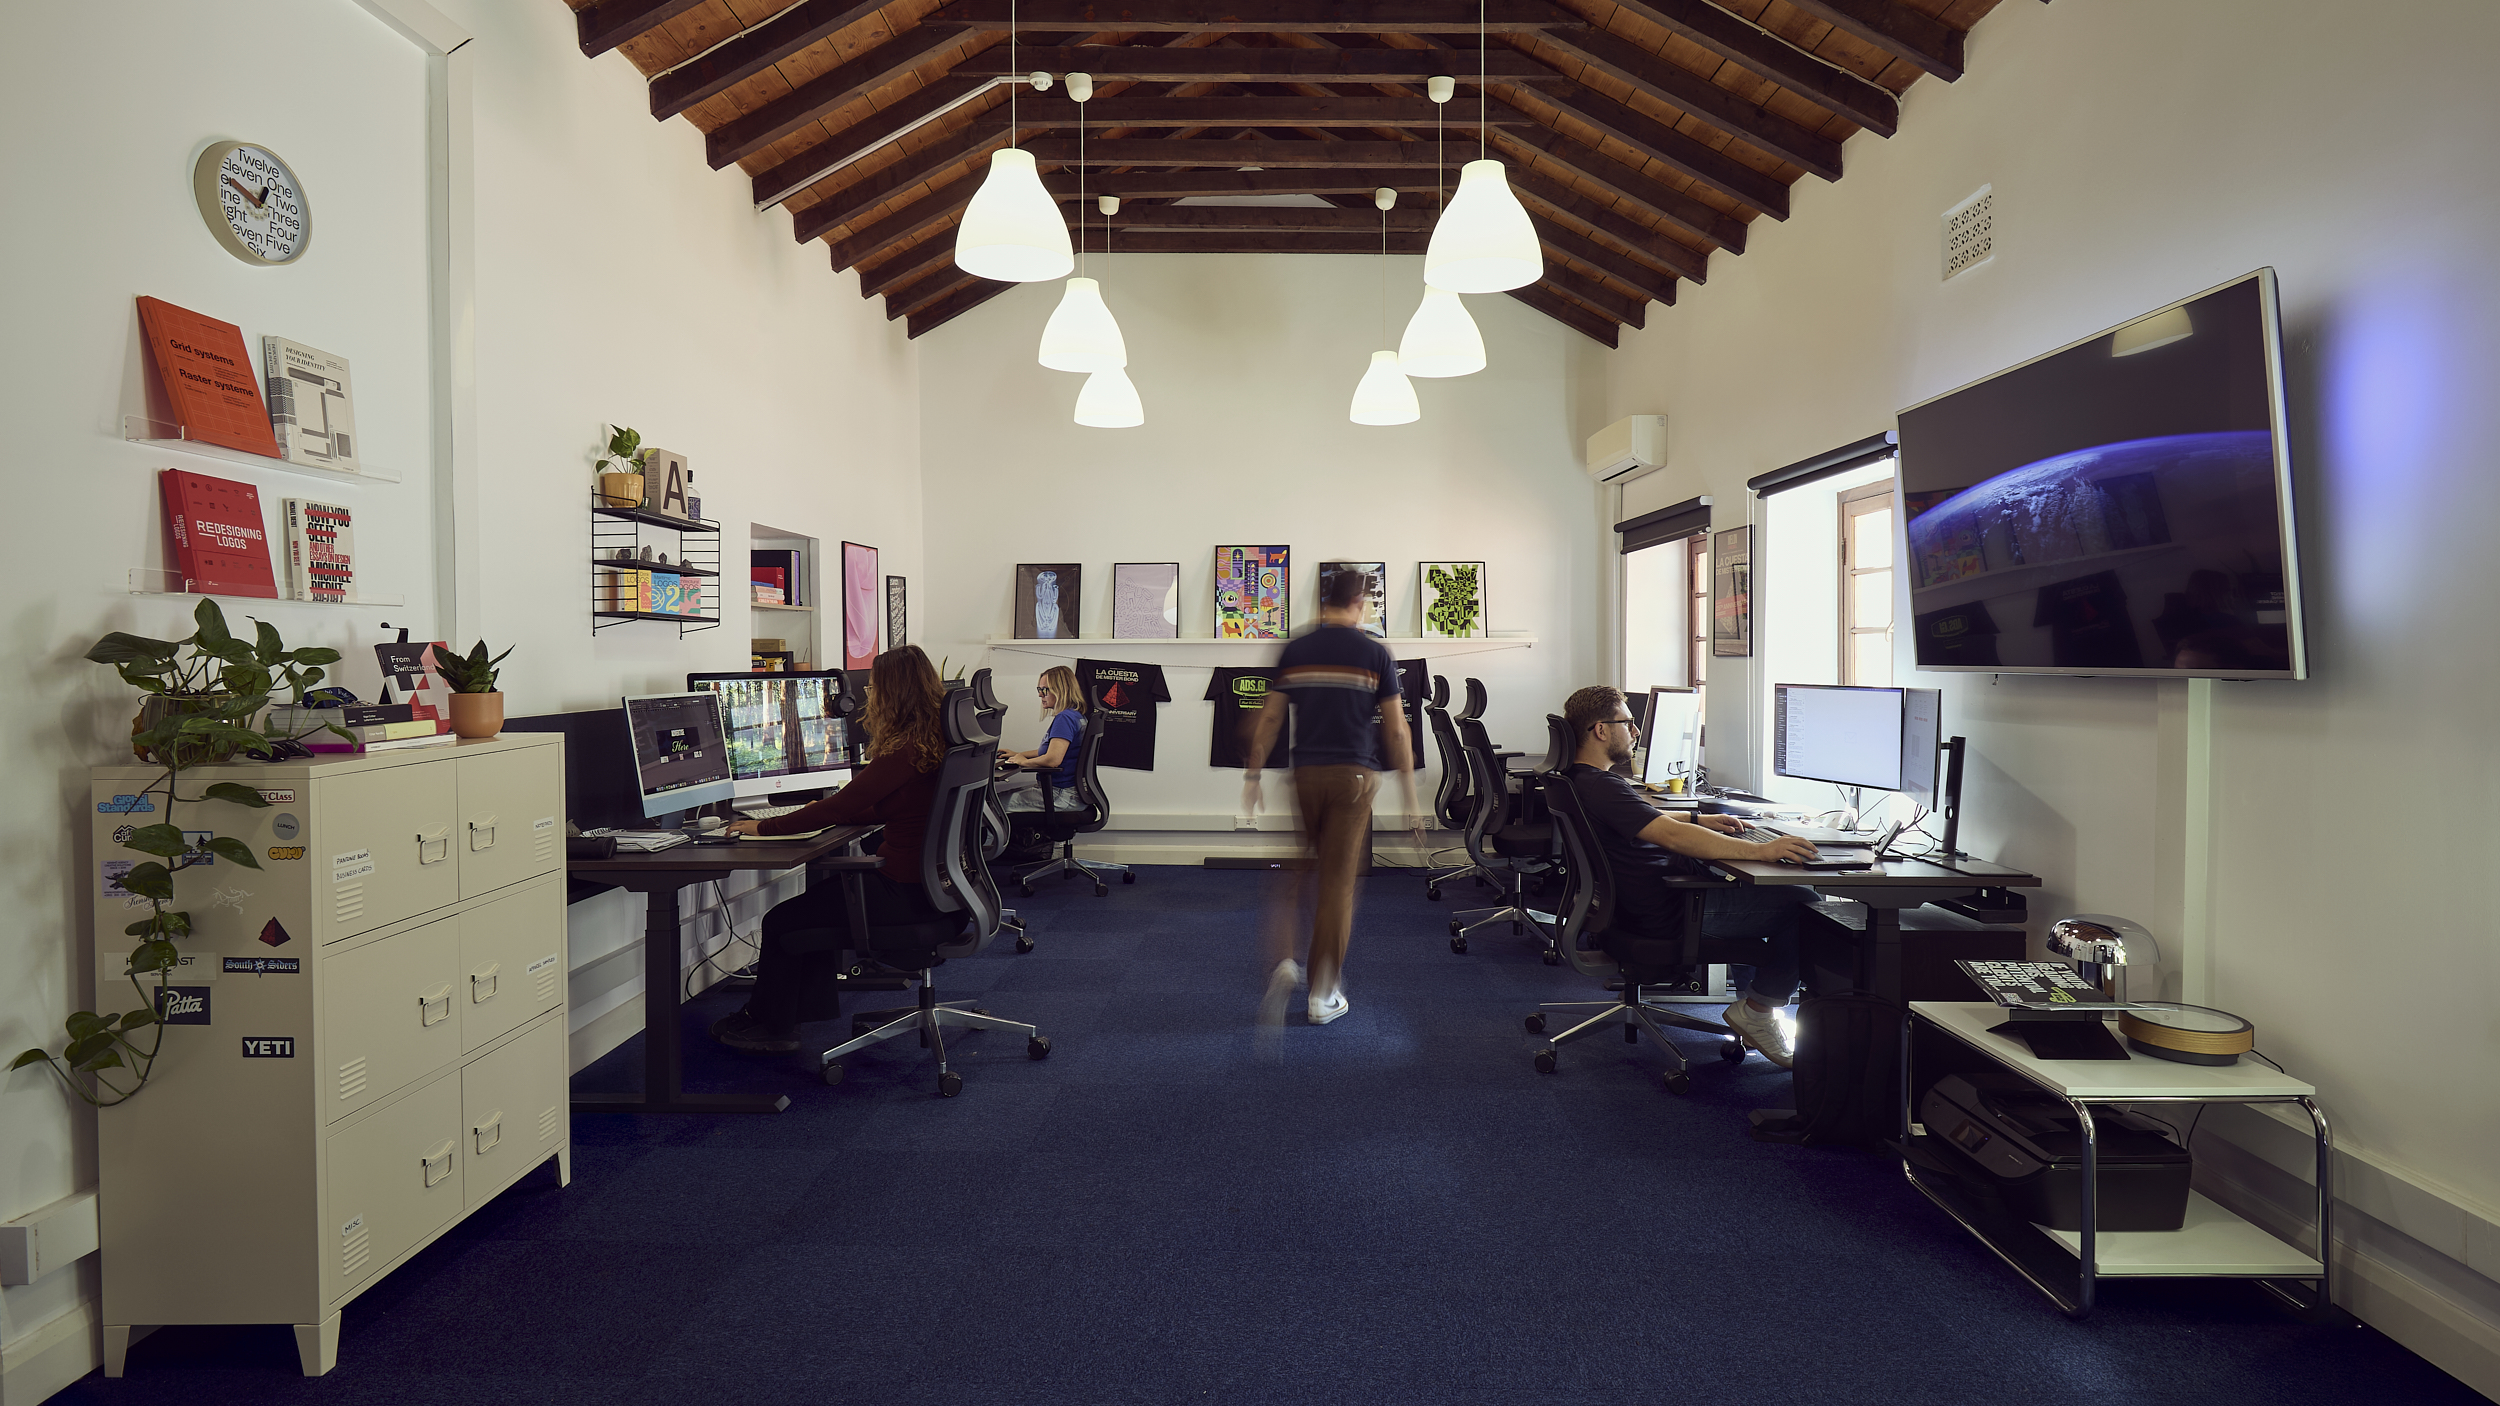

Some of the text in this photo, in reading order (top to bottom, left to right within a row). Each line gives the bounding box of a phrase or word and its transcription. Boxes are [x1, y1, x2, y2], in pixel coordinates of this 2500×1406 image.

[238, 148, 280, 179] Twelve
[221, 157, 293, 199] Eleven One
[220, 185, 241, 205] ine
[273, 193, 298, 215] Two
[222, 201, 300, 231] ight Three
[231, 223, 291, 255] even Five
[269, 221, 298, 243] Four
[247, 241, 267, 259] Six
[170, 338, 192, 354] Grid
[193, 348, 235, 367] systems
[285, 346, 315, 361] DESIGNING
[285, 354, 301, 364] YOUR
[300, 358, 326, 372] IDENTITY
[179, 368, 212, 387] Raster
[214, 379, 255, 398] systeme
[662, 460, 687, 515] A
[306, 502, 350, 528] NOW YOU
[196, 519, 263, 541] REDESIGNING
[216, 535, 248, 550] LOGOS
[309, 541, 335, 554] AND OTHER
[309, 551, 351, 565] ESSAYS ON DESIGN
[653, 579, 678, 588] LOGOS
[665, 586, 681, 613] 2
[390, 655, 411, 664] From
[393, 663, 435, 673] Switzerland
[1095, 668, 1139, 678] LA CUESTA
[1239, 679, 1266, 693] ADS.GI
[97, 802, 155, 813] Standards
[113, 793, 149, 805] Global
[277, 821, 296, 831] LUNCH
[335, 864, 373, 881] BUSINESS CARDS
[225, 959, 298, 972] South Siders
[1967, 961, 1993, 974] ARE
[1984, 961, 2023, 987] CLIENTS
[2000, 961, 2048, 994] POTENTIAL
[2033, 962, 2076, 989] READING
[160, 990, 204, 1022] Patta
[244, 1040, 292, 1055] YETI
